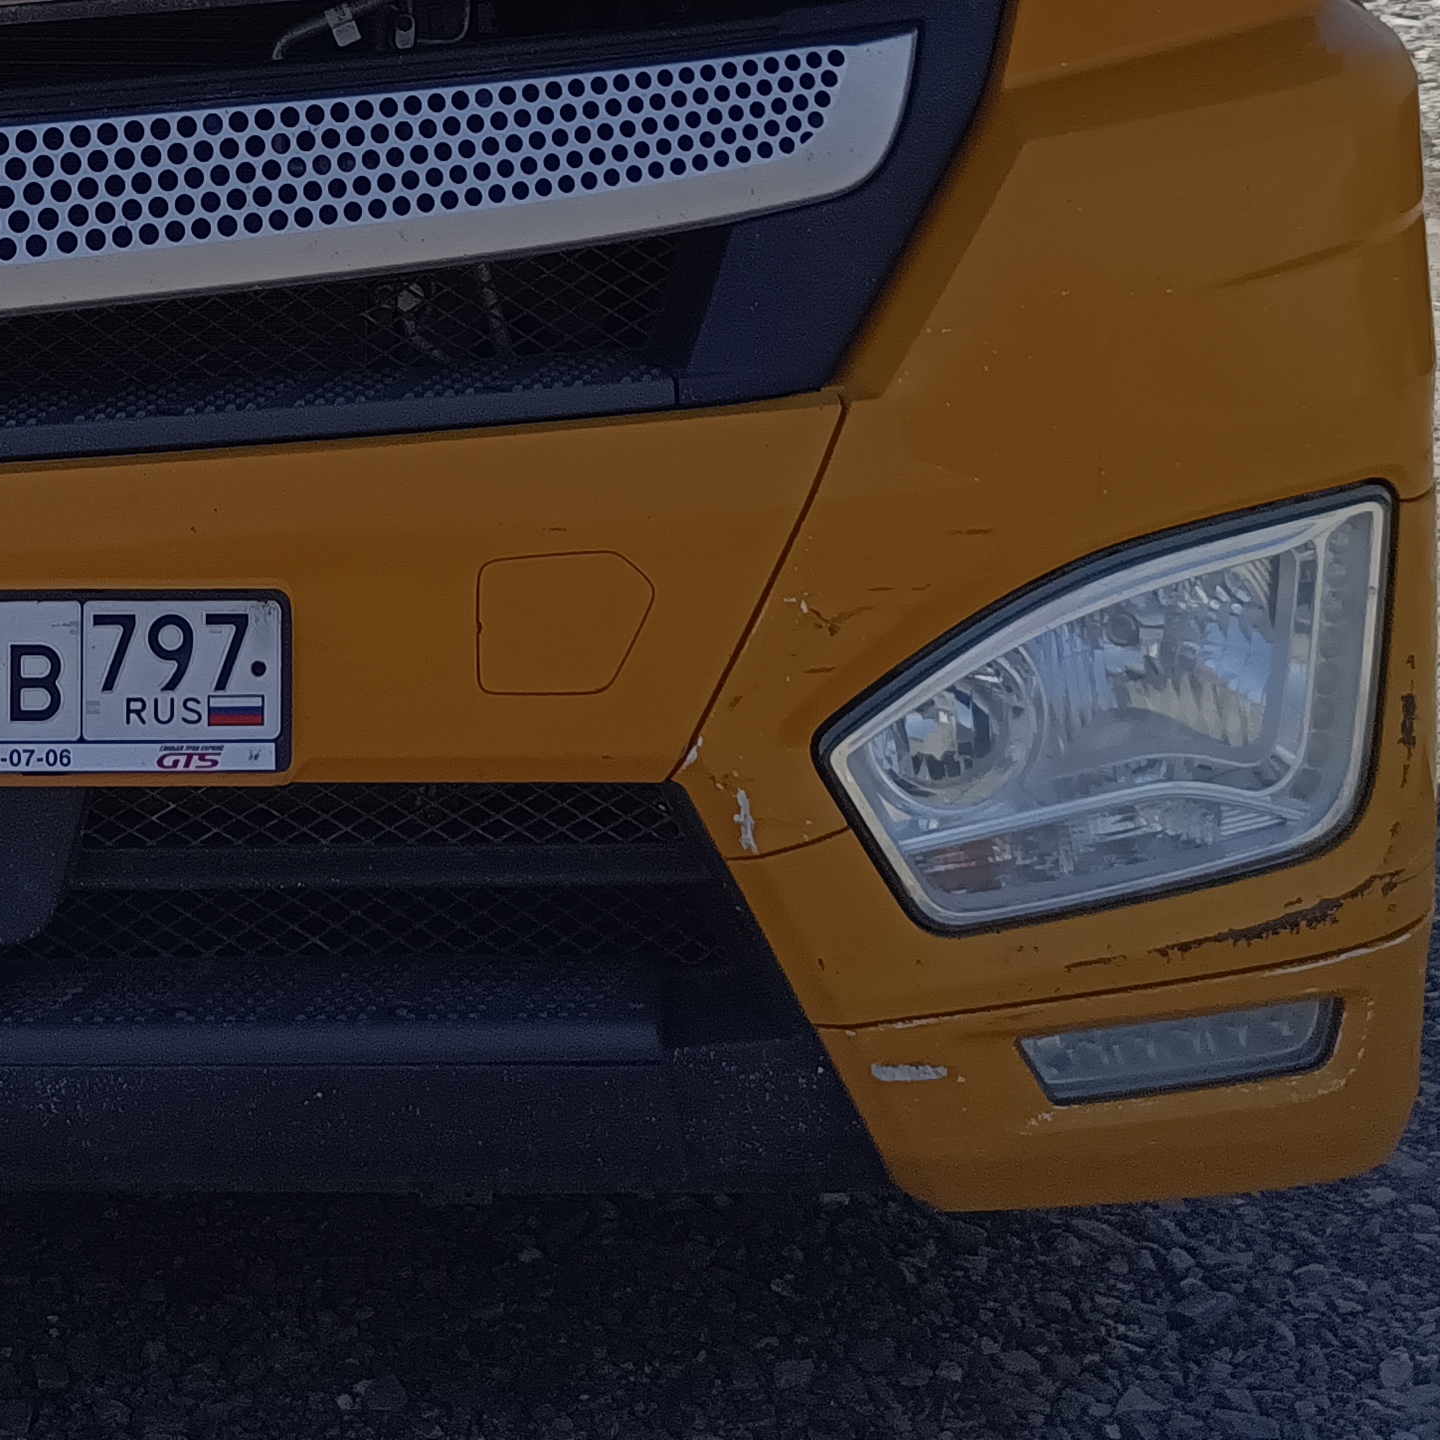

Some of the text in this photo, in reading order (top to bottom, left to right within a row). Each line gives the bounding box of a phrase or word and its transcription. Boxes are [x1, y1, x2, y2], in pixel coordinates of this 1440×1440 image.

[91, 613, 251, 693] 797
[124, 696, 204, 726] RUS
[156, 752, 222, 769] GTS
